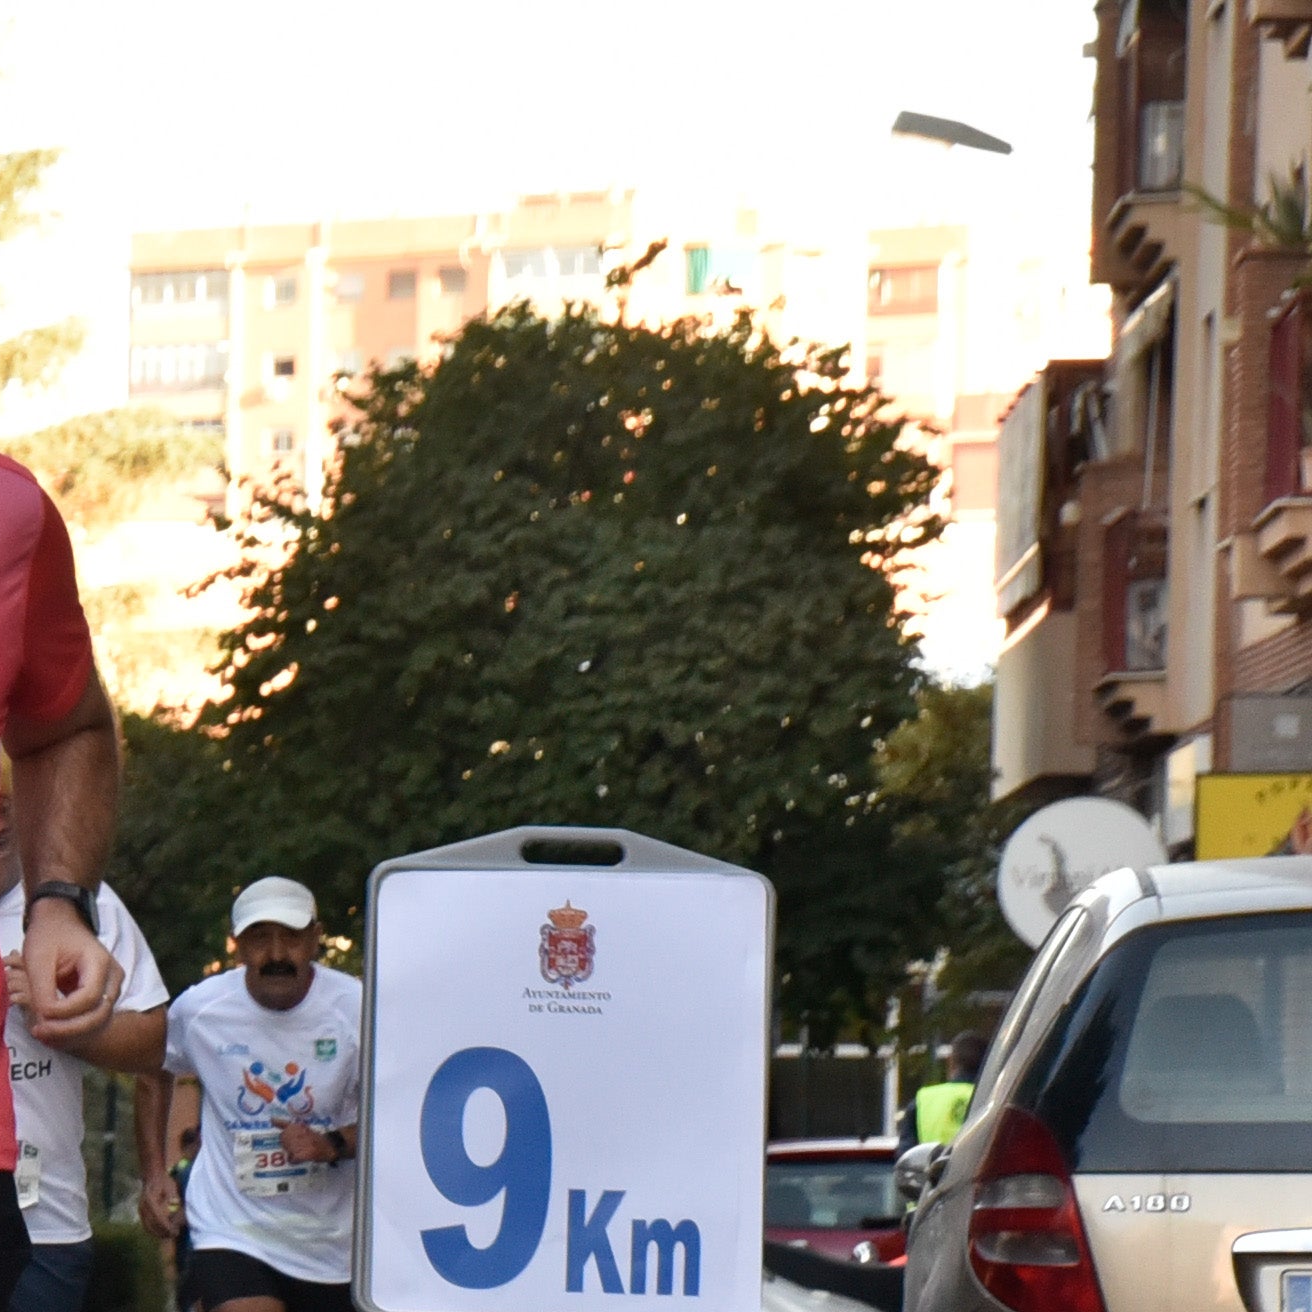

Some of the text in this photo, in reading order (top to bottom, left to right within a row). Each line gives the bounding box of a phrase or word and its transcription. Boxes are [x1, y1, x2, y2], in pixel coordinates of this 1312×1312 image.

[254, 1151, 289, 1169] 38
[420, 1046, 701, 1296] 9 Km
